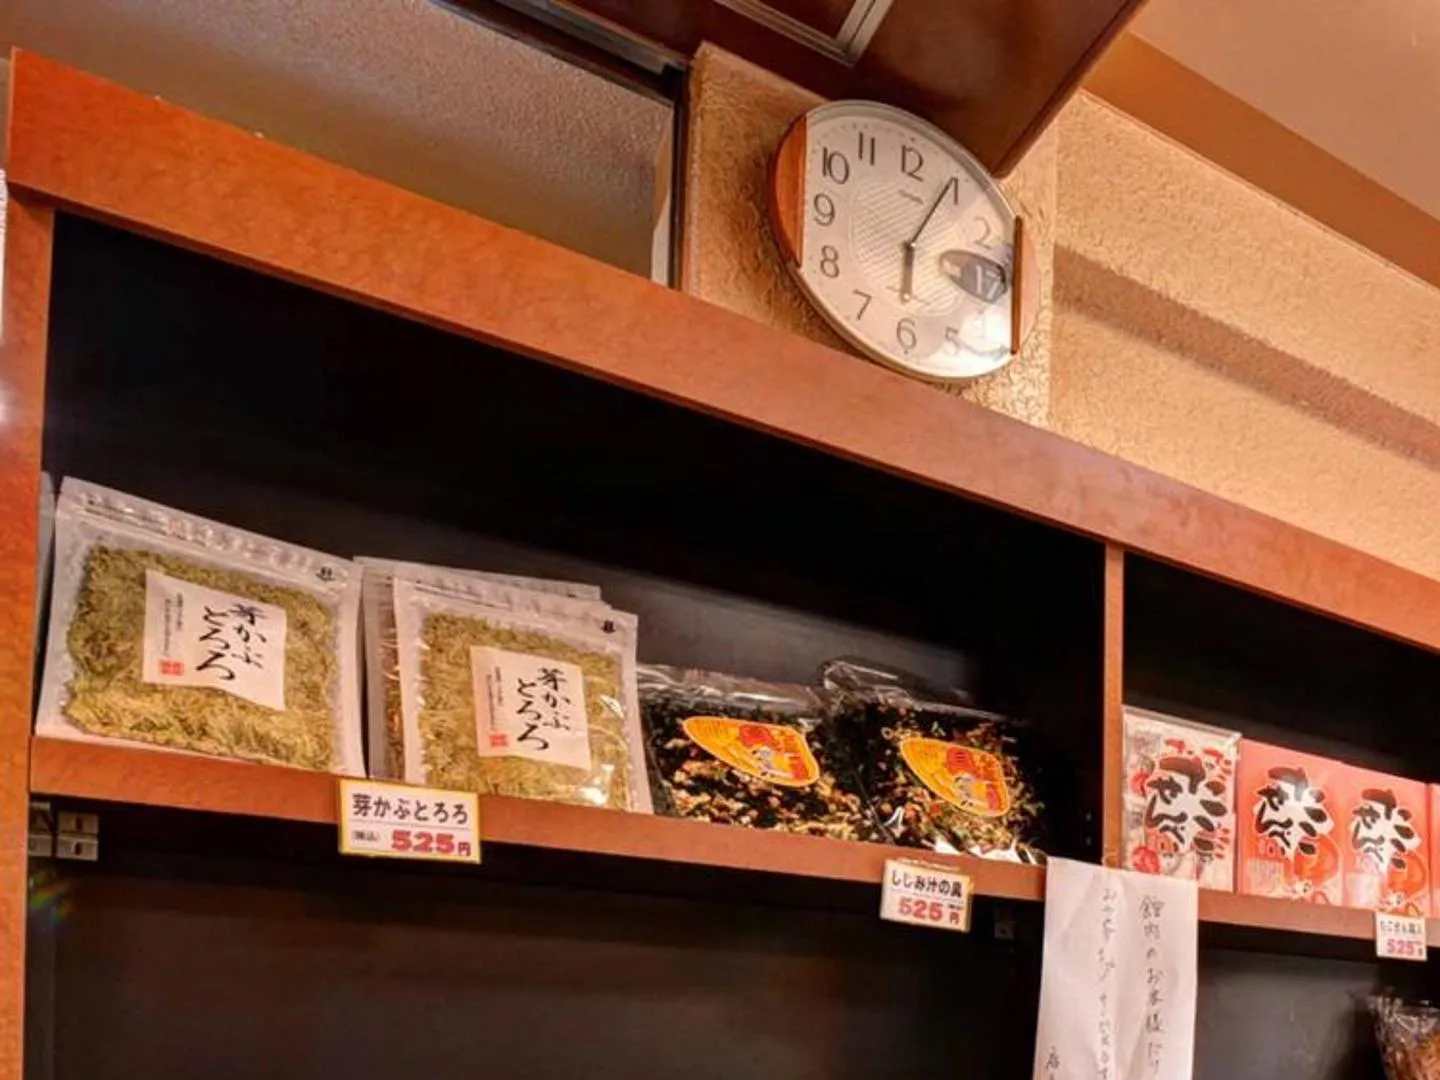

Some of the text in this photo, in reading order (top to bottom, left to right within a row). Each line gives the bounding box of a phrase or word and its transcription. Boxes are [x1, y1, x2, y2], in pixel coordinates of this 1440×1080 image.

[822, 146, 850, 185] 10
[858, 131, 876, 166] 11
[901, 144, 924, 182] 12
[813, 193, 836, 226] 9
[819, 245, 840, 279] 8
[852, 288, 872, 321] 7
[896, 317, 918, 351] 6
[516, 677, 550, 751] とろろ
[352, 792, 469, 825] 芽かぶとろろ
